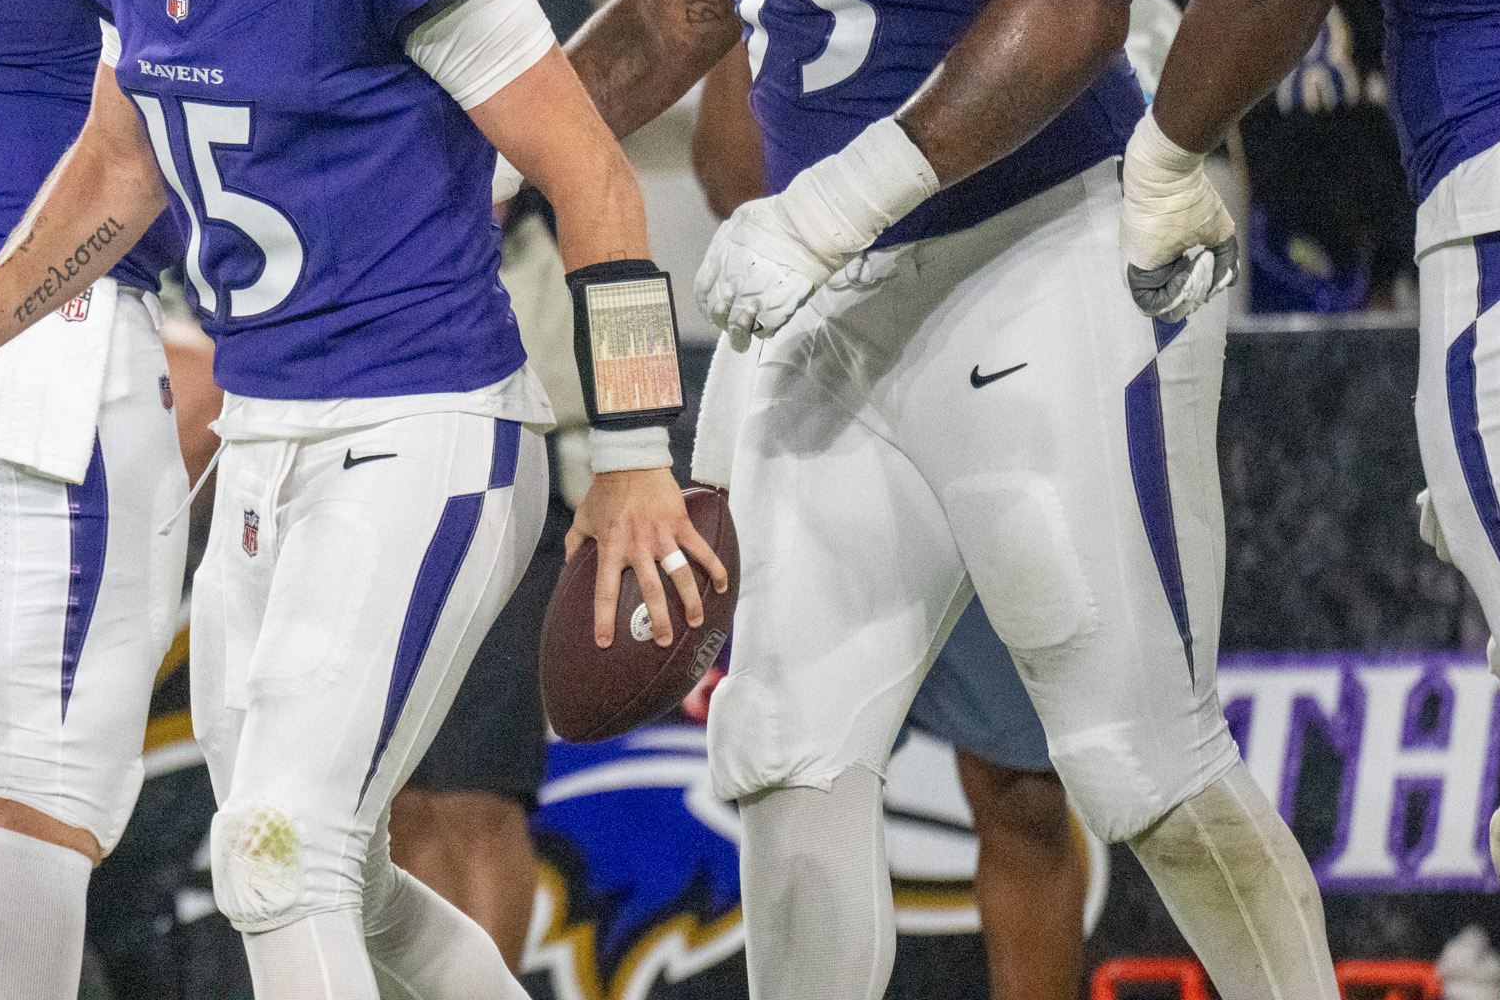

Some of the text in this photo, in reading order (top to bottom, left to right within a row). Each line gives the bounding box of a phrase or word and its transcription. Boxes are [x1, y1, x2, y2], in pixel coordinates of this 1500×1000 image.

[169, 0, 186, 17] NFL
[137, 58, 224, 86] RAVENS
[131, 93, 305, 319] 15
